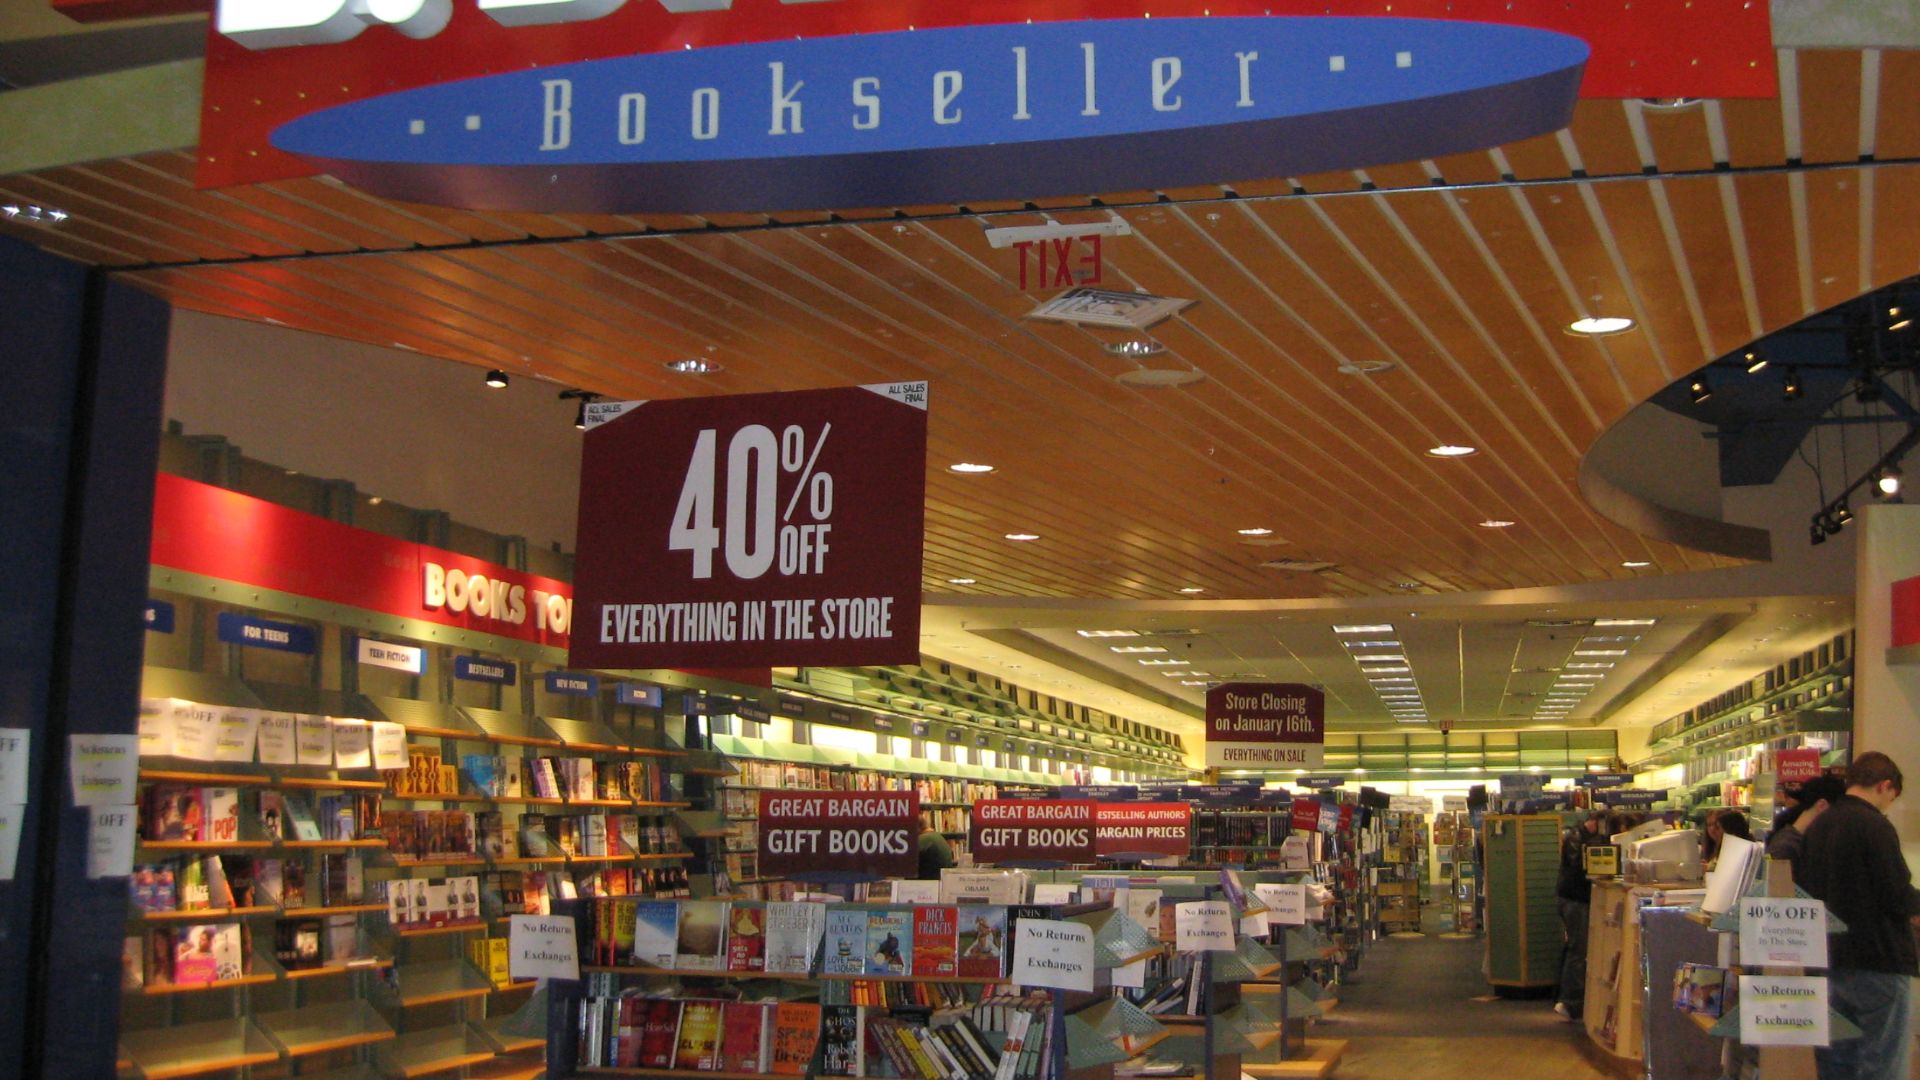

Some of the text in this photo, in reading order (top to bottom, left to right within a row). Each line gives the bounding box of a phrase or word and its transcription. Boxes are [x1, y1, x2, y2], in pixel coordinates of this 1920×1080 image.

[540, 42, 1258, 151] Bookseller
[888, 384, 925, 394] ALL SALES
[904, 394, 925, 402] FINAL
[602, 404, 622, 413] SALES
[669, 422, 832, 580] 40%
[778, 524, 832, 577] OFF
[424, 561, 527, 625] BOOKS
[600, 597, 894, 643] EVERYTHING IN THE STORE
[243, 625, 290, 643] FOR TEENS
[386, 650, 411, 663] FICTION
[1226, 692, 1306, 714] Store Closing
[1215, 714, 1315, 735] on January 16th.
[1223, 748, 1307, 762] EVERYTHING ON SALE
[1782, 760, 1815, 768] Amazing
[768, 798, 909, 817] GREAT BARGAIN
[981, 805, 1089, 820] GREAT BARGAIN
[1147, 810, 1186, 820] AUTHORS
[980, 828, 1089, 847] GIFT BOOKS
[1146, 826, 1186, 838] PRICES
[767, 829, 909, 854] GIFT BOOKS
[965, 885, 990, 893] OBAMA
[925, 909, 945, 921] DICK
[1018, 908, 1042, 918] JOHN
[1184, 908, 1227, 916] No Returns
[1747, 905, 1819, 920] 40% OFF
[523, 923, 537, 932] No
[918, 922, 952, 935] FRANCIS
[1186, 929, 1228, 938] Exchanges
[1761, 927, 1807, 936] Everything
[1028, 928, 1086, 942] No Returns
[1770, 937, 1784, 945] The
[524, 950, 572, 963] Exchanges
[1028, 957, 1082, 973] Exchanges
[1752, 984, 1816, 995] No Returns
[1755, 1015, 1814, 1028] Exchanges
